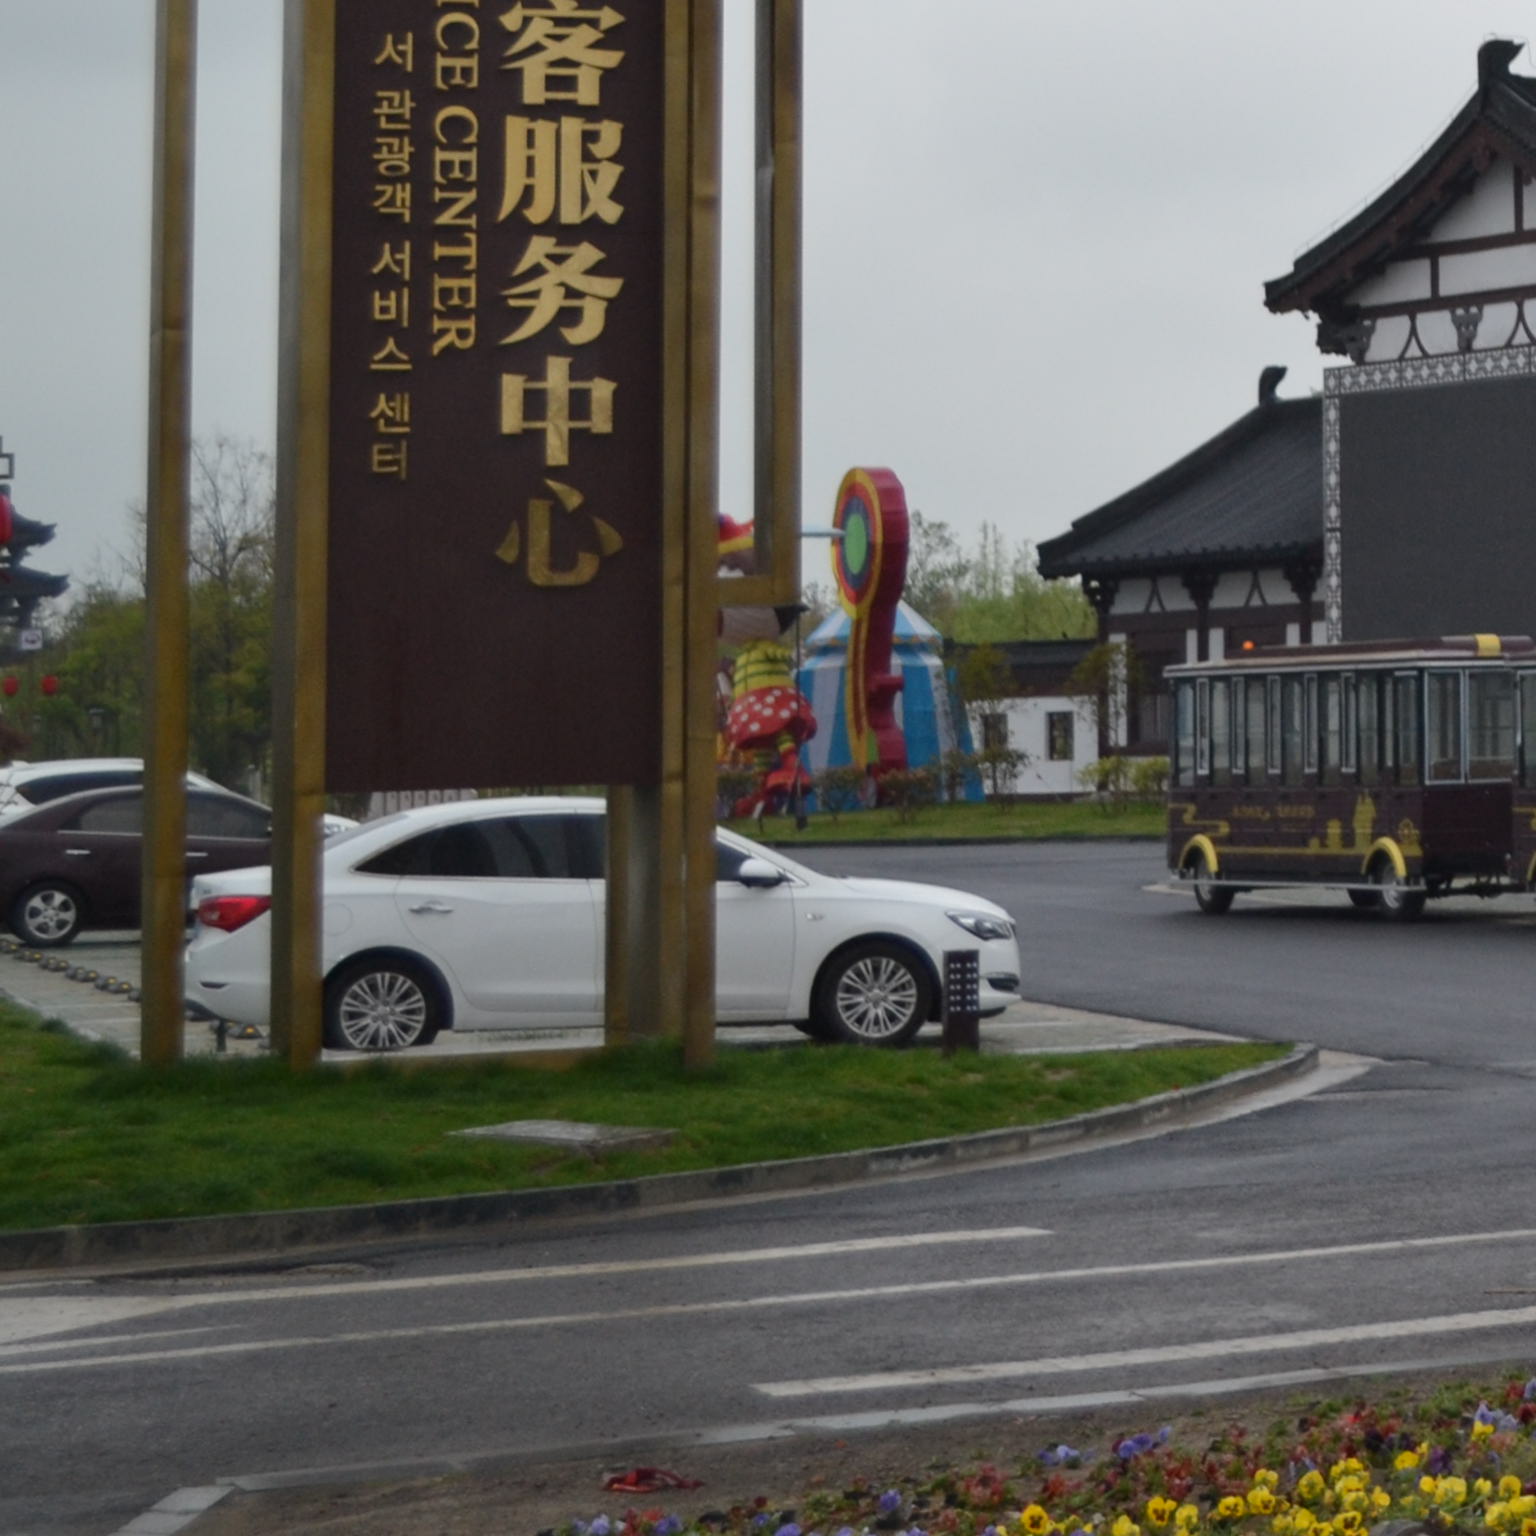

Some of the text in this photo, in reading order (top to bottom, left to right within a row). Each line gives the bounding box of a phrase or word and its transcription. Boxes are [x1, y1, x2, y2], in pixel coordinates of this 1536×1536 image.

[368, 31, 417, 480] 서 관광객 서비스 센터
[430, 104, 479, 357] CENTER
